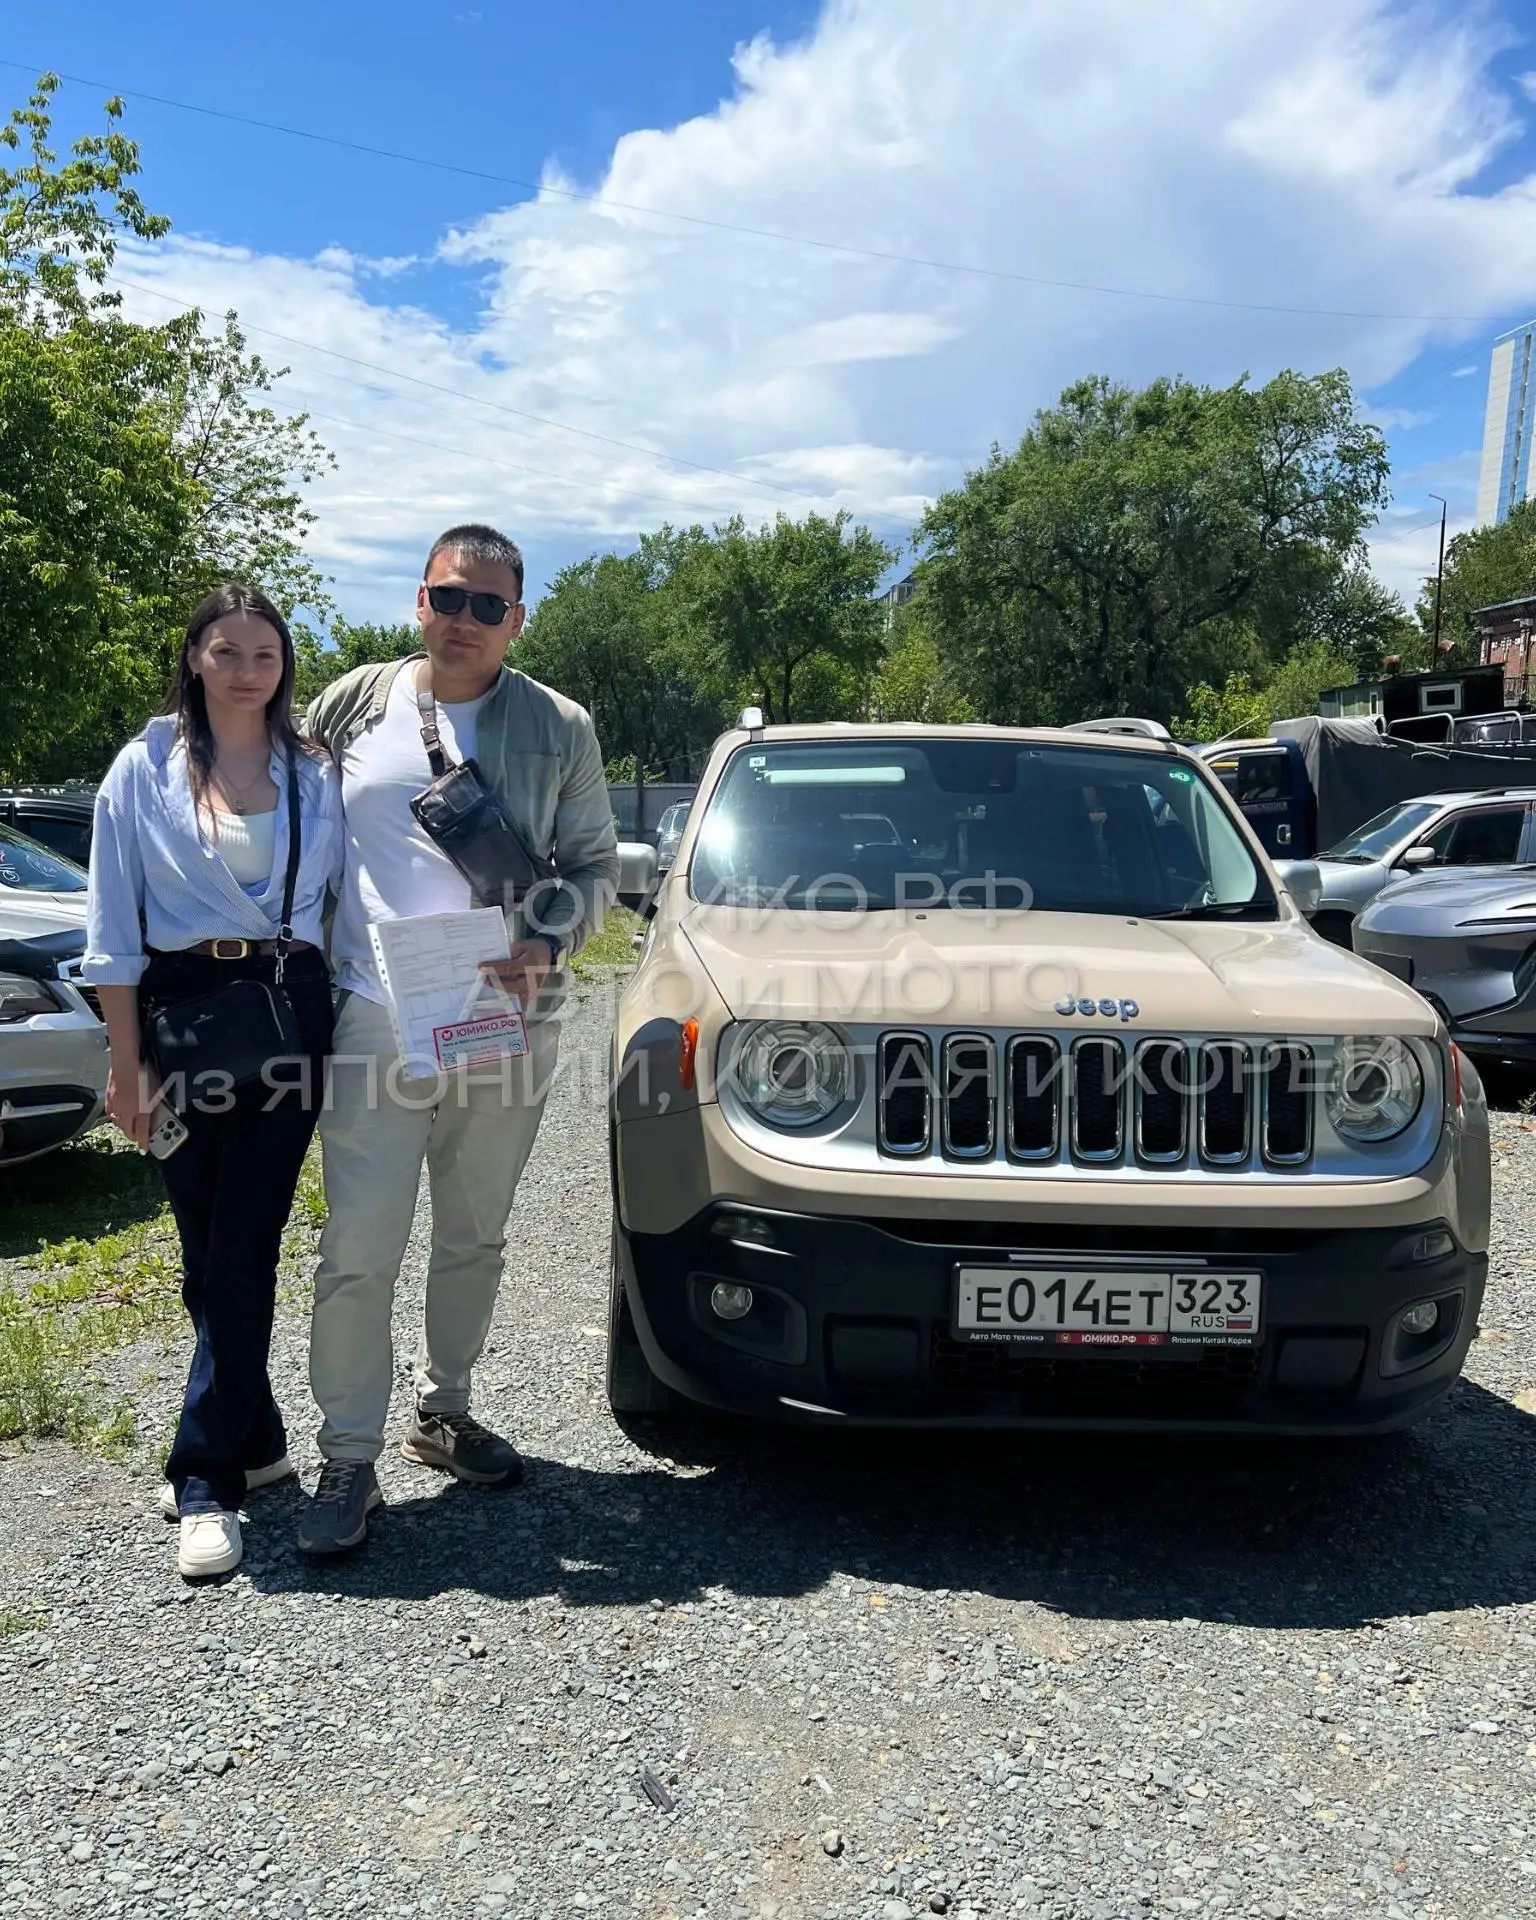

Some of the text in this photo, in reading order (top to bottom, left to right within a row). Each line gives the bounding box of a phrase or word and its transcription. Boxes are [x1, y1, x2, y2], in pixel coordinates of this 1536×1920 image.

[1054, 993, 1139, 1022] Jeep
[456, 1020, 517, 1037] ЮМИКО.РФ
[1175, 1279, 1247, 1314] 323
[1191, 1315, 1225, 1328] RUS
[969, 1332, 1044, 1342] Авто Мото техника
[1081, 1334, 1137, 1344] ЮМИКО.РФ
[1171, 1336, 1252, 1345] Япония Китай Корея
